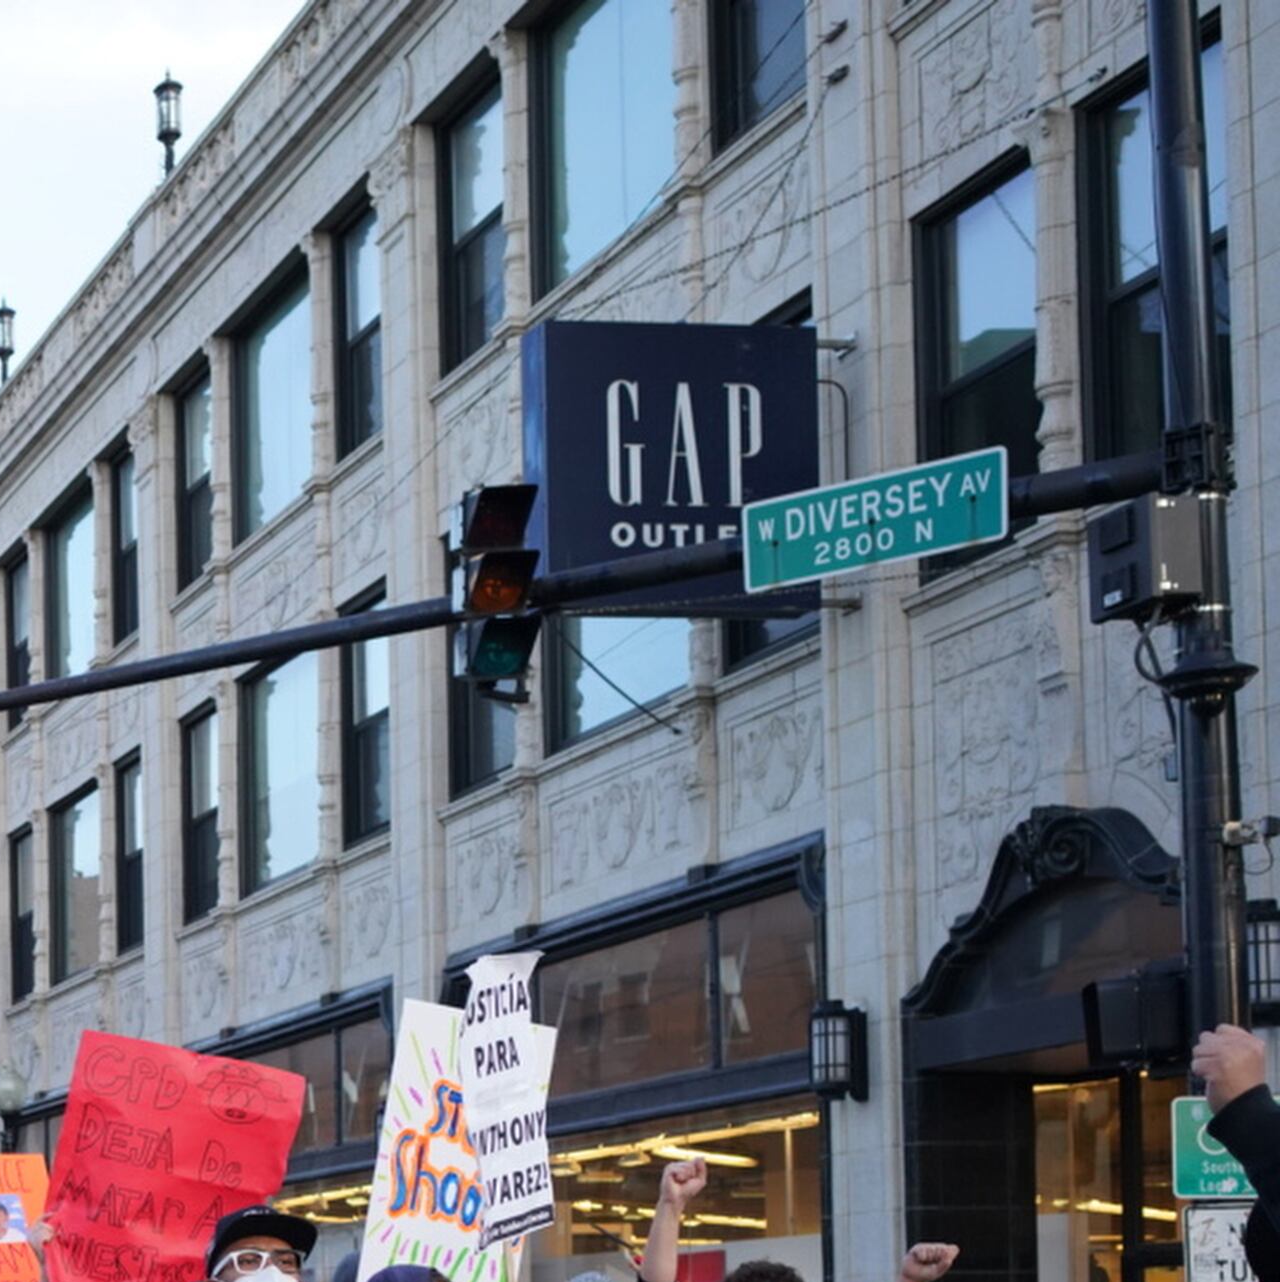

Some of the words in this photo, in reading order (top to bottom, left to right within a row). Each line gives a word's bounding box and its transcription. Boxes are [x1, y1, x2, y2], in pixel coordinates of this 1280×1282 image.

[606, 378, 763, 507] GAP
[758, 518, 775, 542] W
[785, 472, 953, 541] DIVERSEY
[959, 469, 990, 497] AV
[610, 521, 738, 548] OUTLE
[814, 528, 894, 566] 2800
[915, 518, 933, 543] N
[82, 1044, 188, 1111] CPD
[474, 1036, 520, 1079] PARA
[77, 1103, 174, 1174] DEJA
[484, 1161, 549, 1209] VAREZ!
